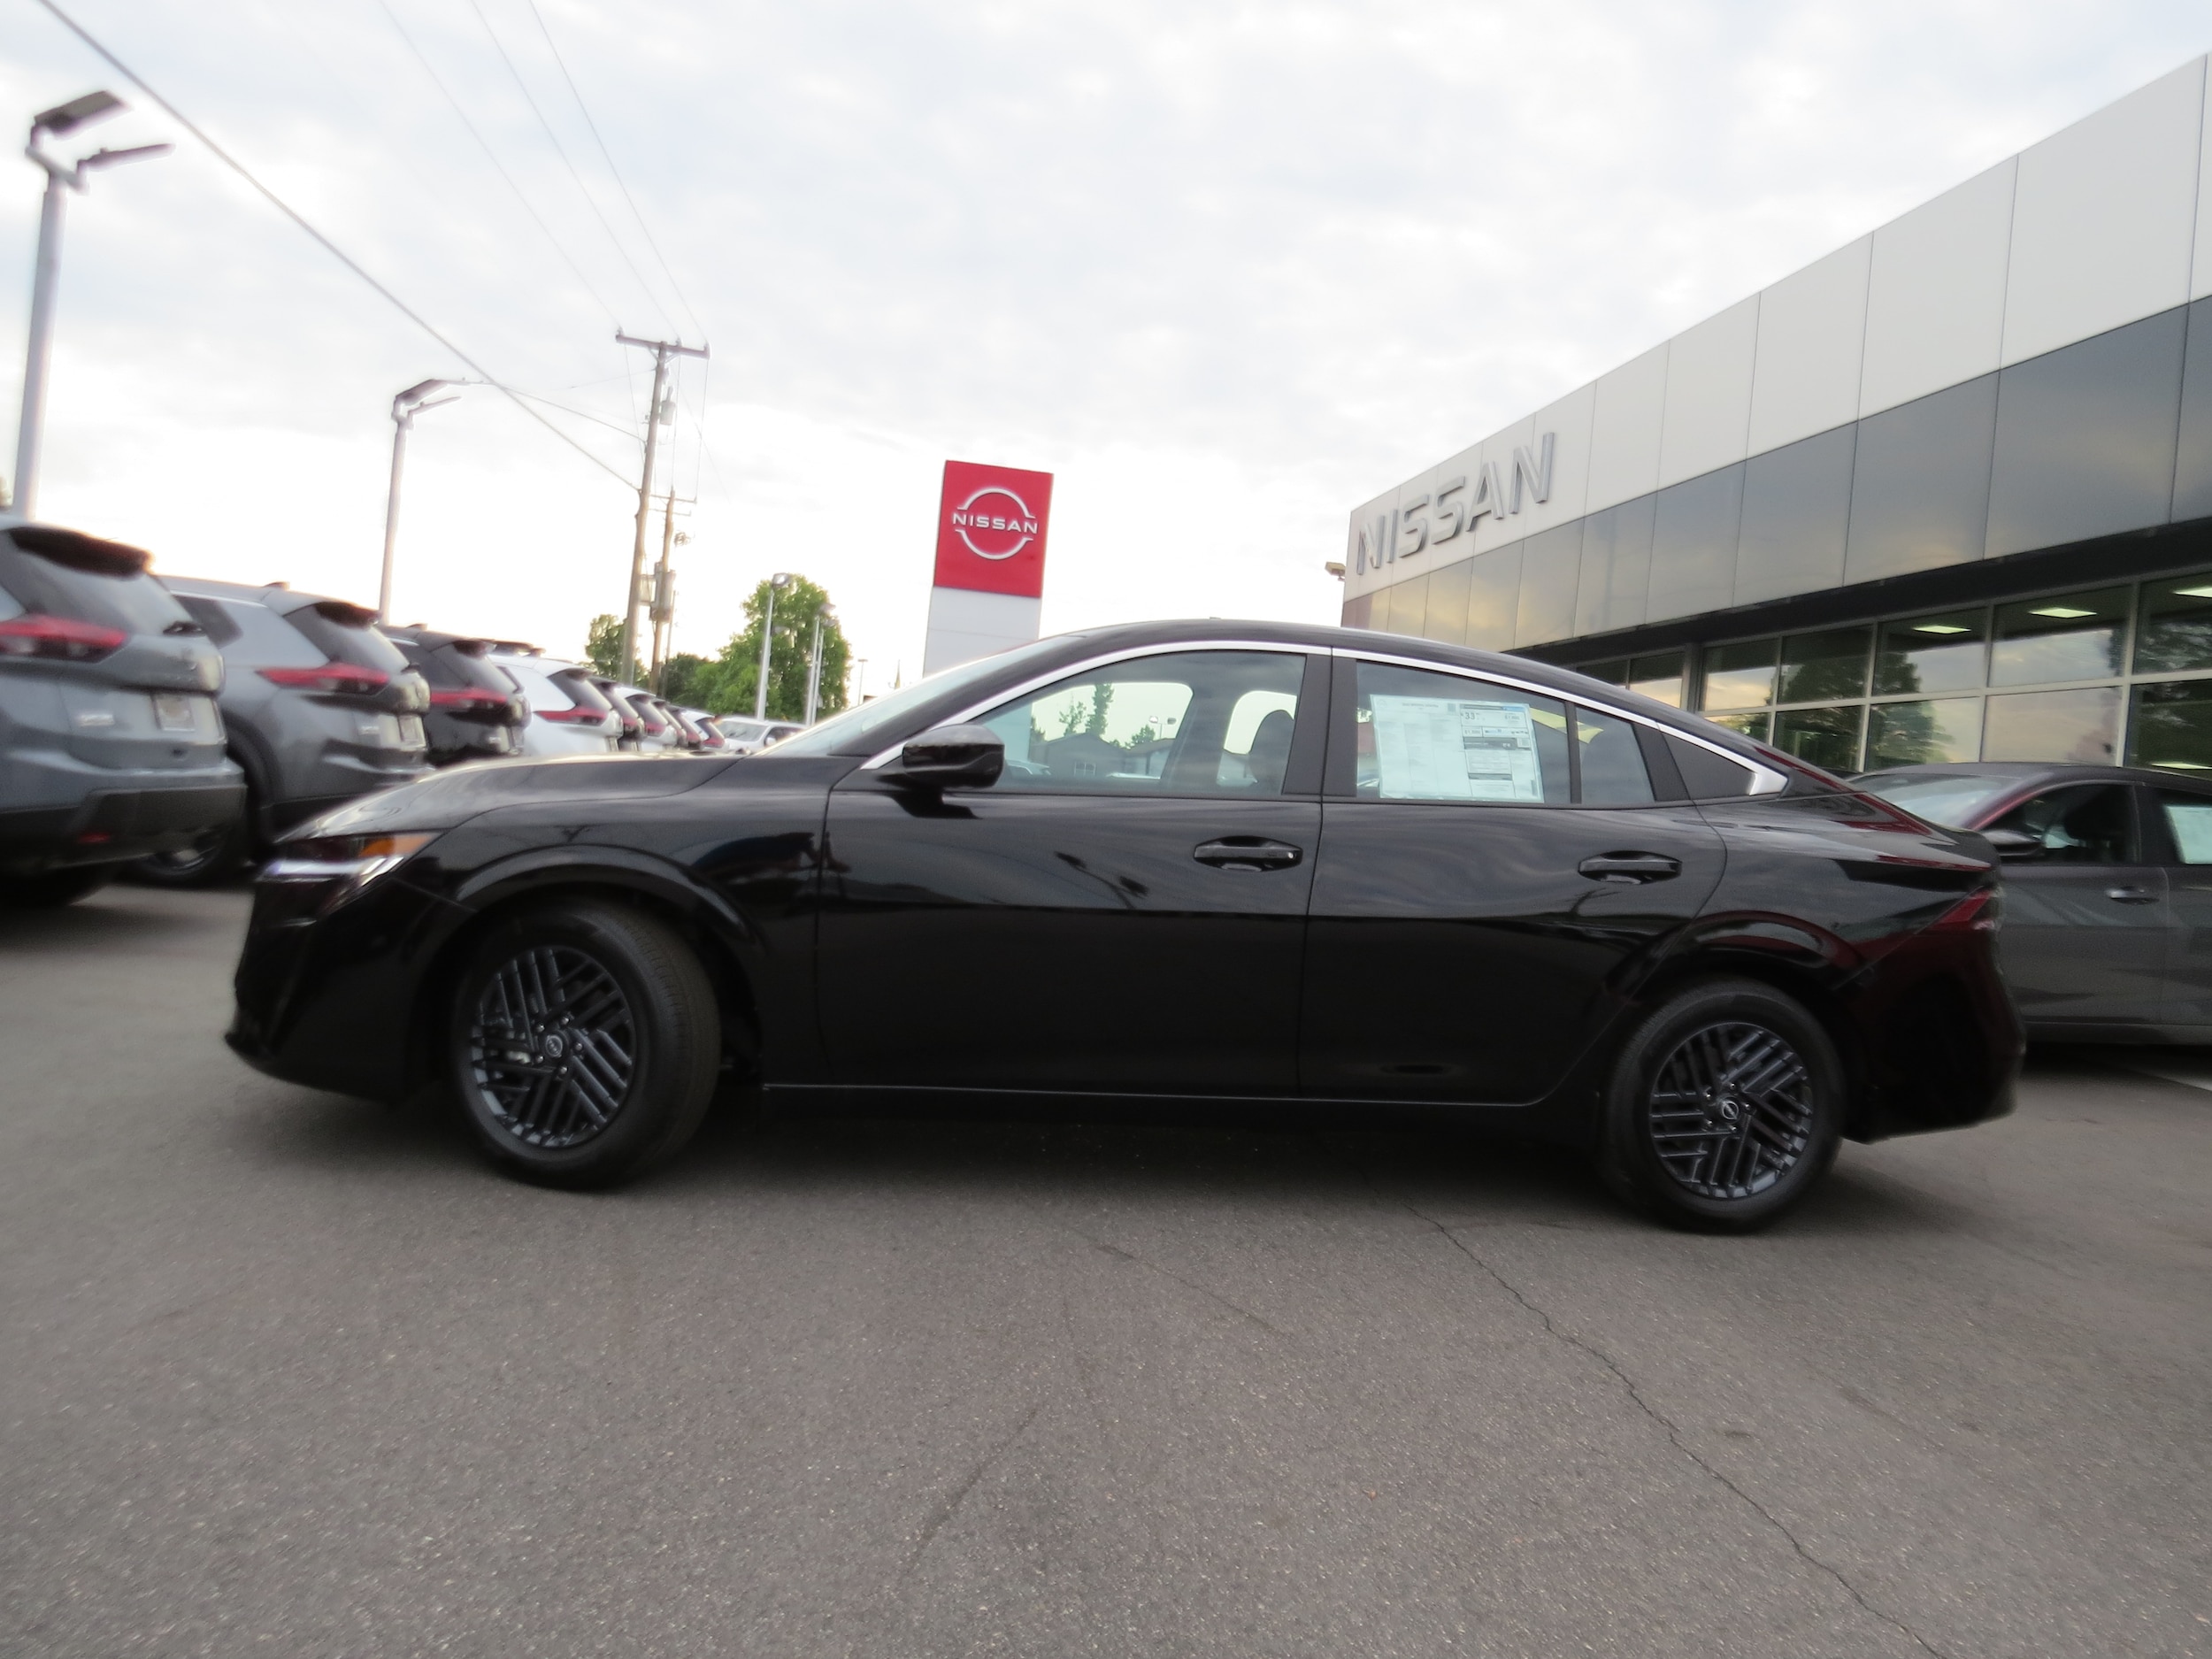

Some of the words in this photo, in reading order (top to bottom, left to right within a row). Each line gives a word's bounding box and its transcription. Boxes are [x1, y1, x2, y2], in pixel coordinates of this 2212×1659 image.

[1356, 432, 1555, 576] NISSAN
[952, 512, 1038, 534] NISSAN
[1464, 711, 1476, 720] 33
